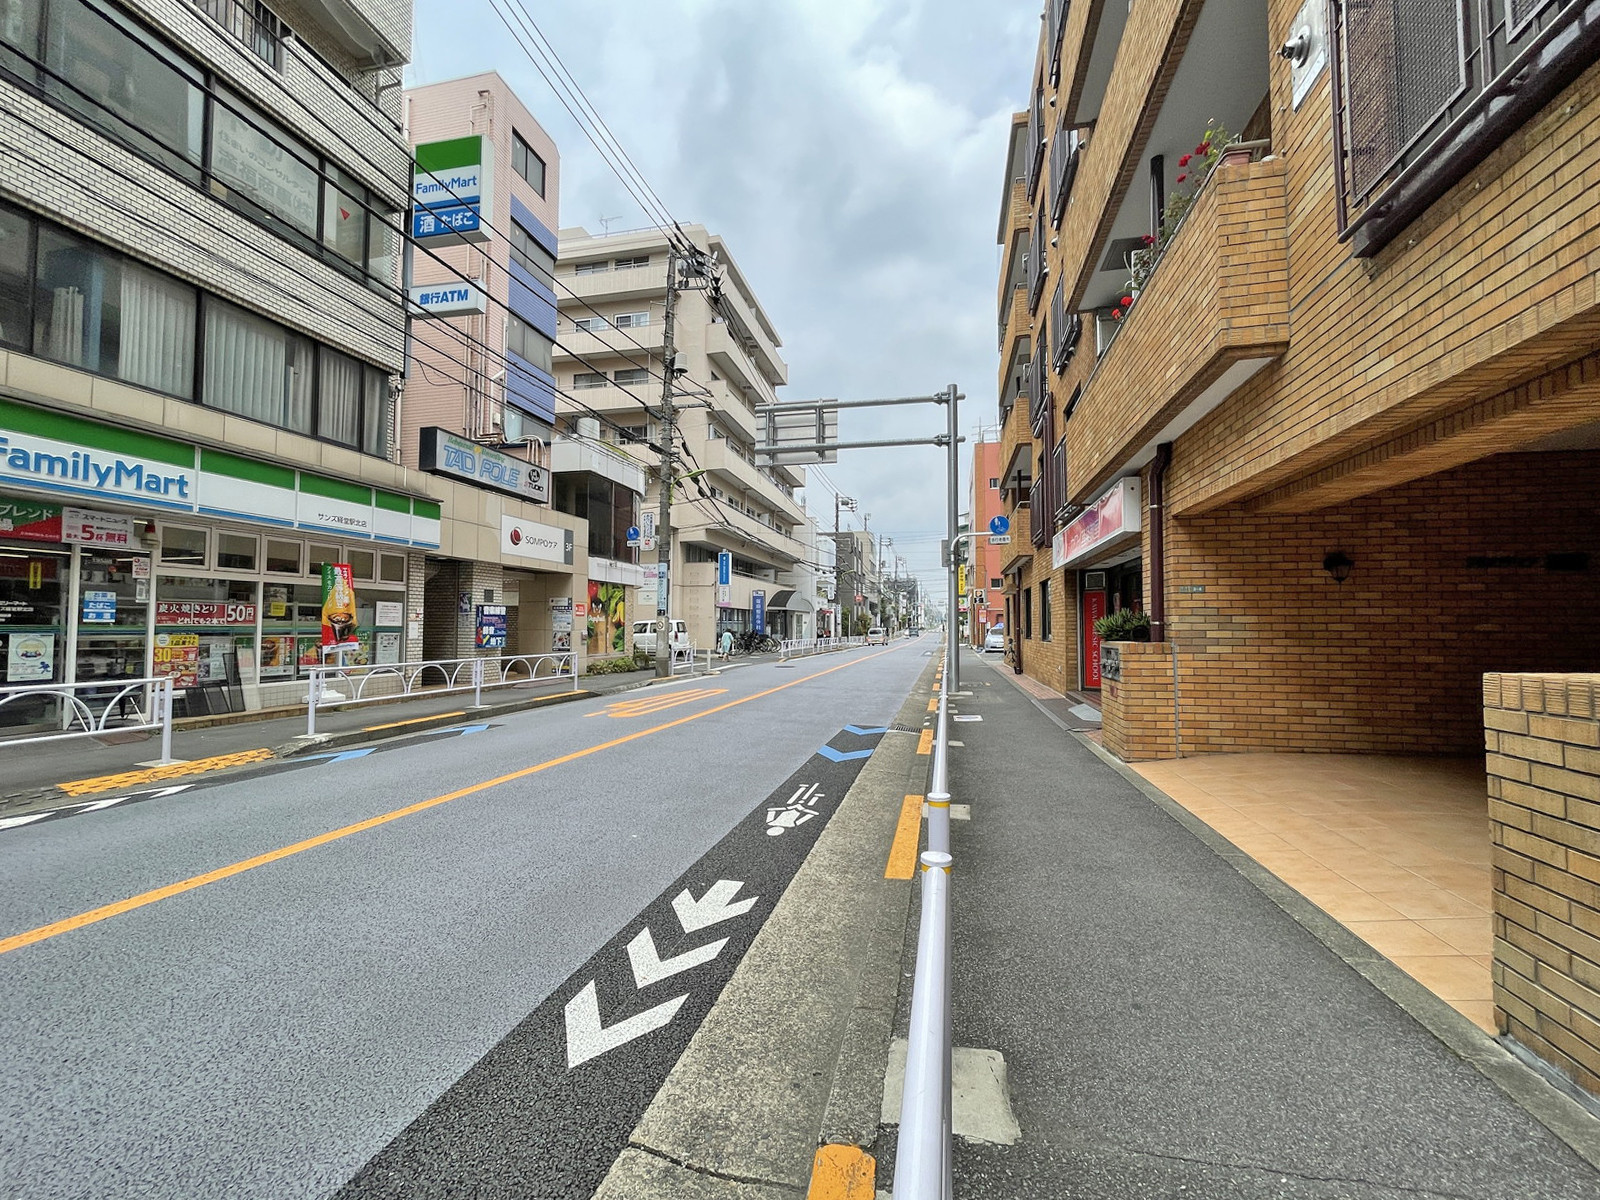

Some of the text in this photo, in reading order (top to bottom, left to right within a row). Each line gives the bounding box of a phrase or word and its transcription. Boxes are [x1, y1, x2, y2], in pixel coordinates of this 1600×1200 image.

[416, 175, 477, 195] FamilyMart
[419, 212, 474, 233] 酒 たばこ
[419, 289, 469, 305] 銀行ATM
[444, 445, 520, 488] TAD POLE
